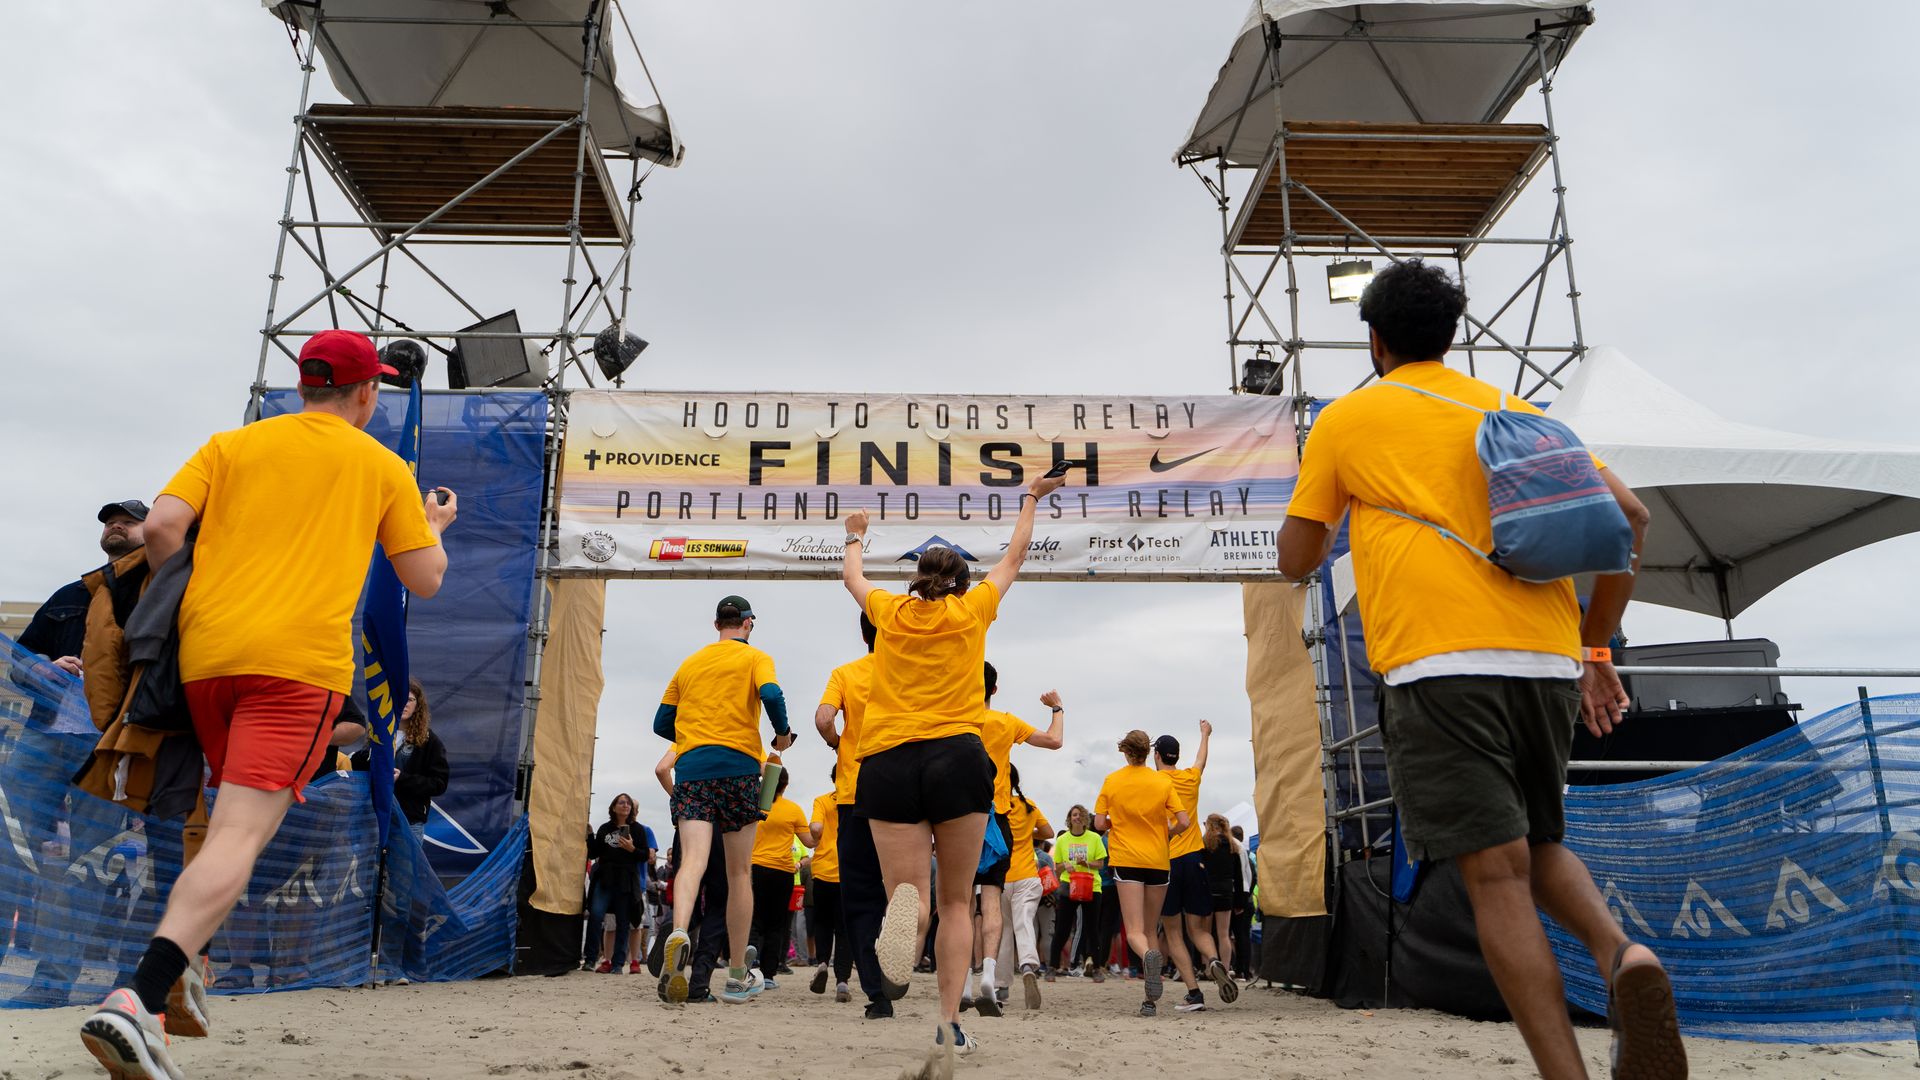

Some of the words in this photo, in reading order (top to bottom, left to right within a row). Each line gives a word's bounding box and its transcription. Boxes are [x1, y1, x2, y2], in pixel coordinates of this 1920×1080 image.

[683, 402, 790, 429] HOOD
[827, 402, 869, 429] TO
[907, 403, 1036, 430] COAST
[1073, 403, 1196, 430] RELAY
[605, 452, 721, 467] PROVIDENCE
[748, 441, 1099, 487] FINISH
[616, 490, 839, 520] PORTLAND
[877, 492, 919, 520] TO
[1128, 488, 1250, 519] RELAY
[781, 535, 872, 554] Knockarod
[1000, 536, 1061, 553] aska
[1089, 537, 1124, 549] First
[1146, 536, 1180, 548] Tech
[1210, 530, 1276, 547] ATHLETI
[661, 540, 685, 555] Tires
[687, 543, 702, 553] LES
[703, 543, 743, 552] SCHWAB
[1223, 551, 1264, 561] BREWING
